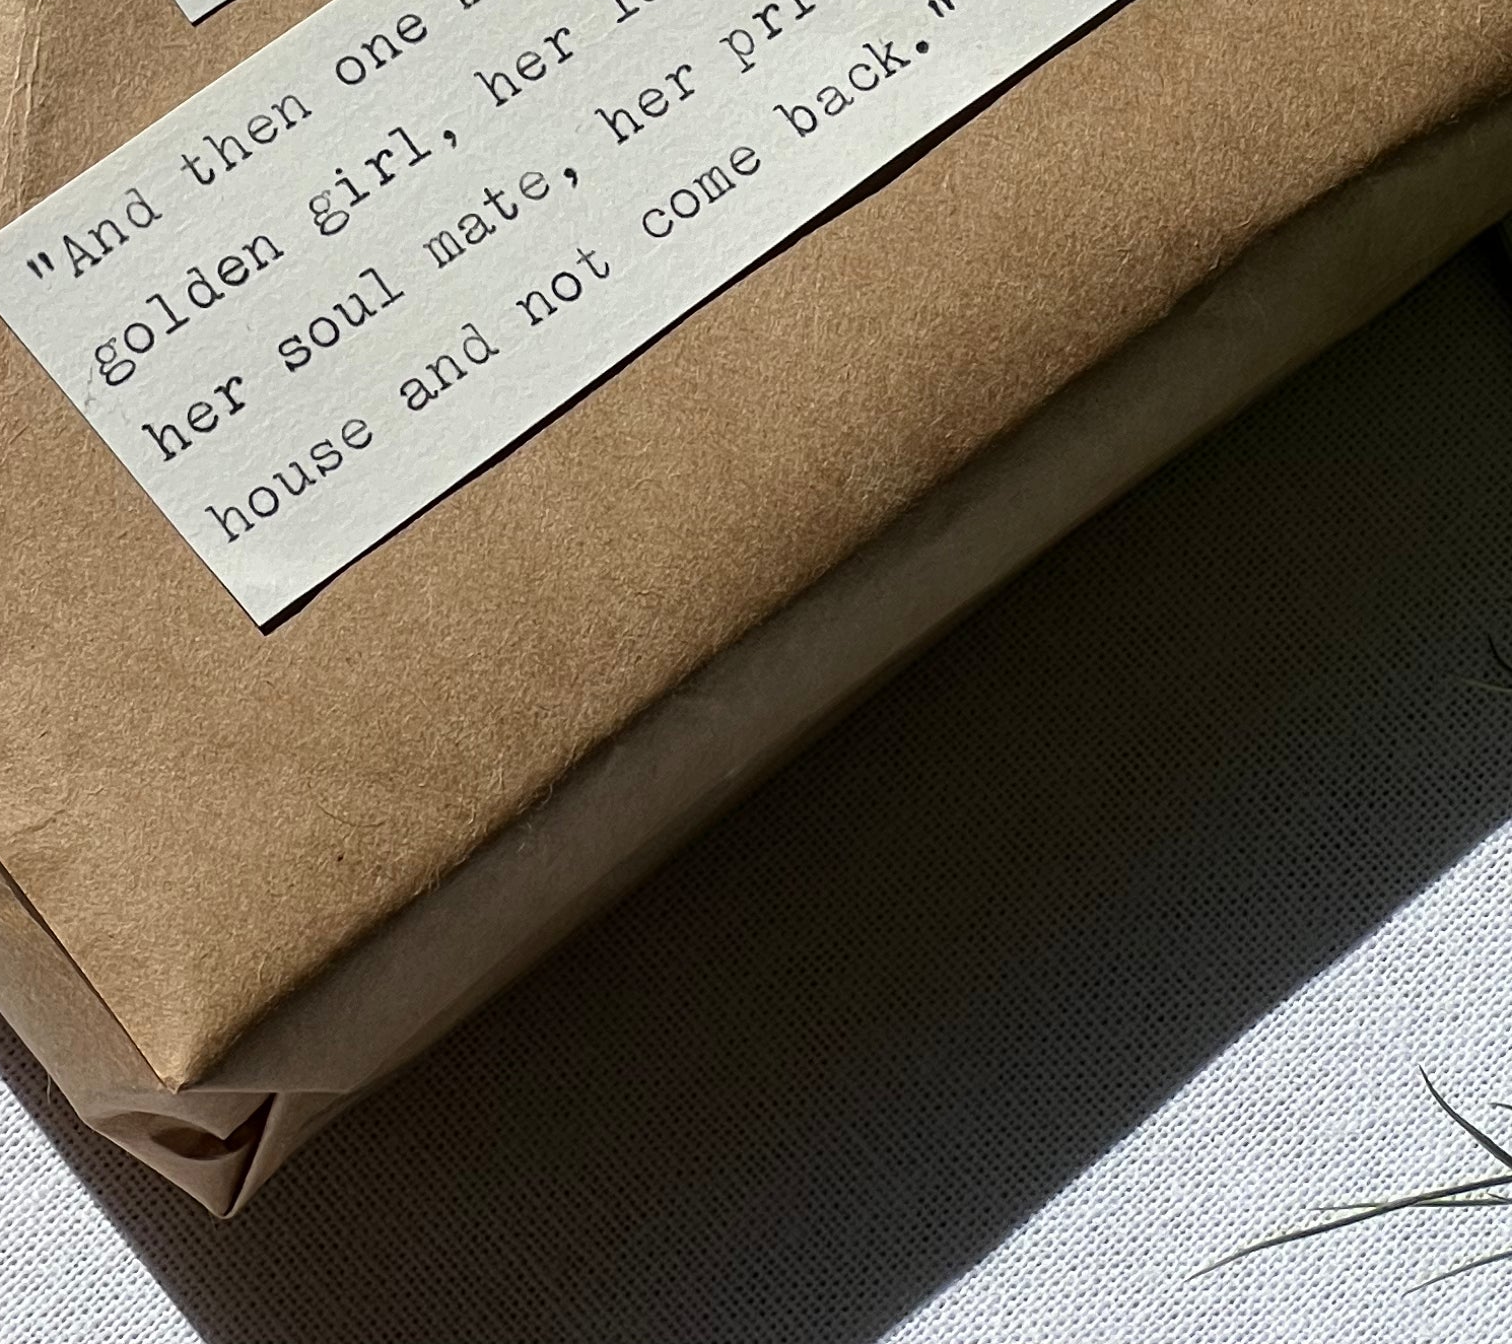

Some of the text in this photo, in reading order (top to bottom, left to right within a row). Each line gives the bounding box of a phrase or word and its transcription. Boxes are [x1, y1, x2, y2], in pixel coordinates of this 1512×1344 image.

[26, 187, 164, 280] "And
[179, 94, 313, 186] then
[335, 13, 428, 86] one
[93, 235, 285, 387] golden
[308, 126, 457, 237] girl,
[473, 27, 574, 108] her
[141, 375, 247, 463] her
[277, 267, 406, 373] soul
[422, 167, 579, 269] mate,
[593, 63, 696, 146] her
[204, 418, 373, 544] house
[399, 322, 500, 412] and
[515, 247, 611, 327] not
[641, 146, 761, 239] come
